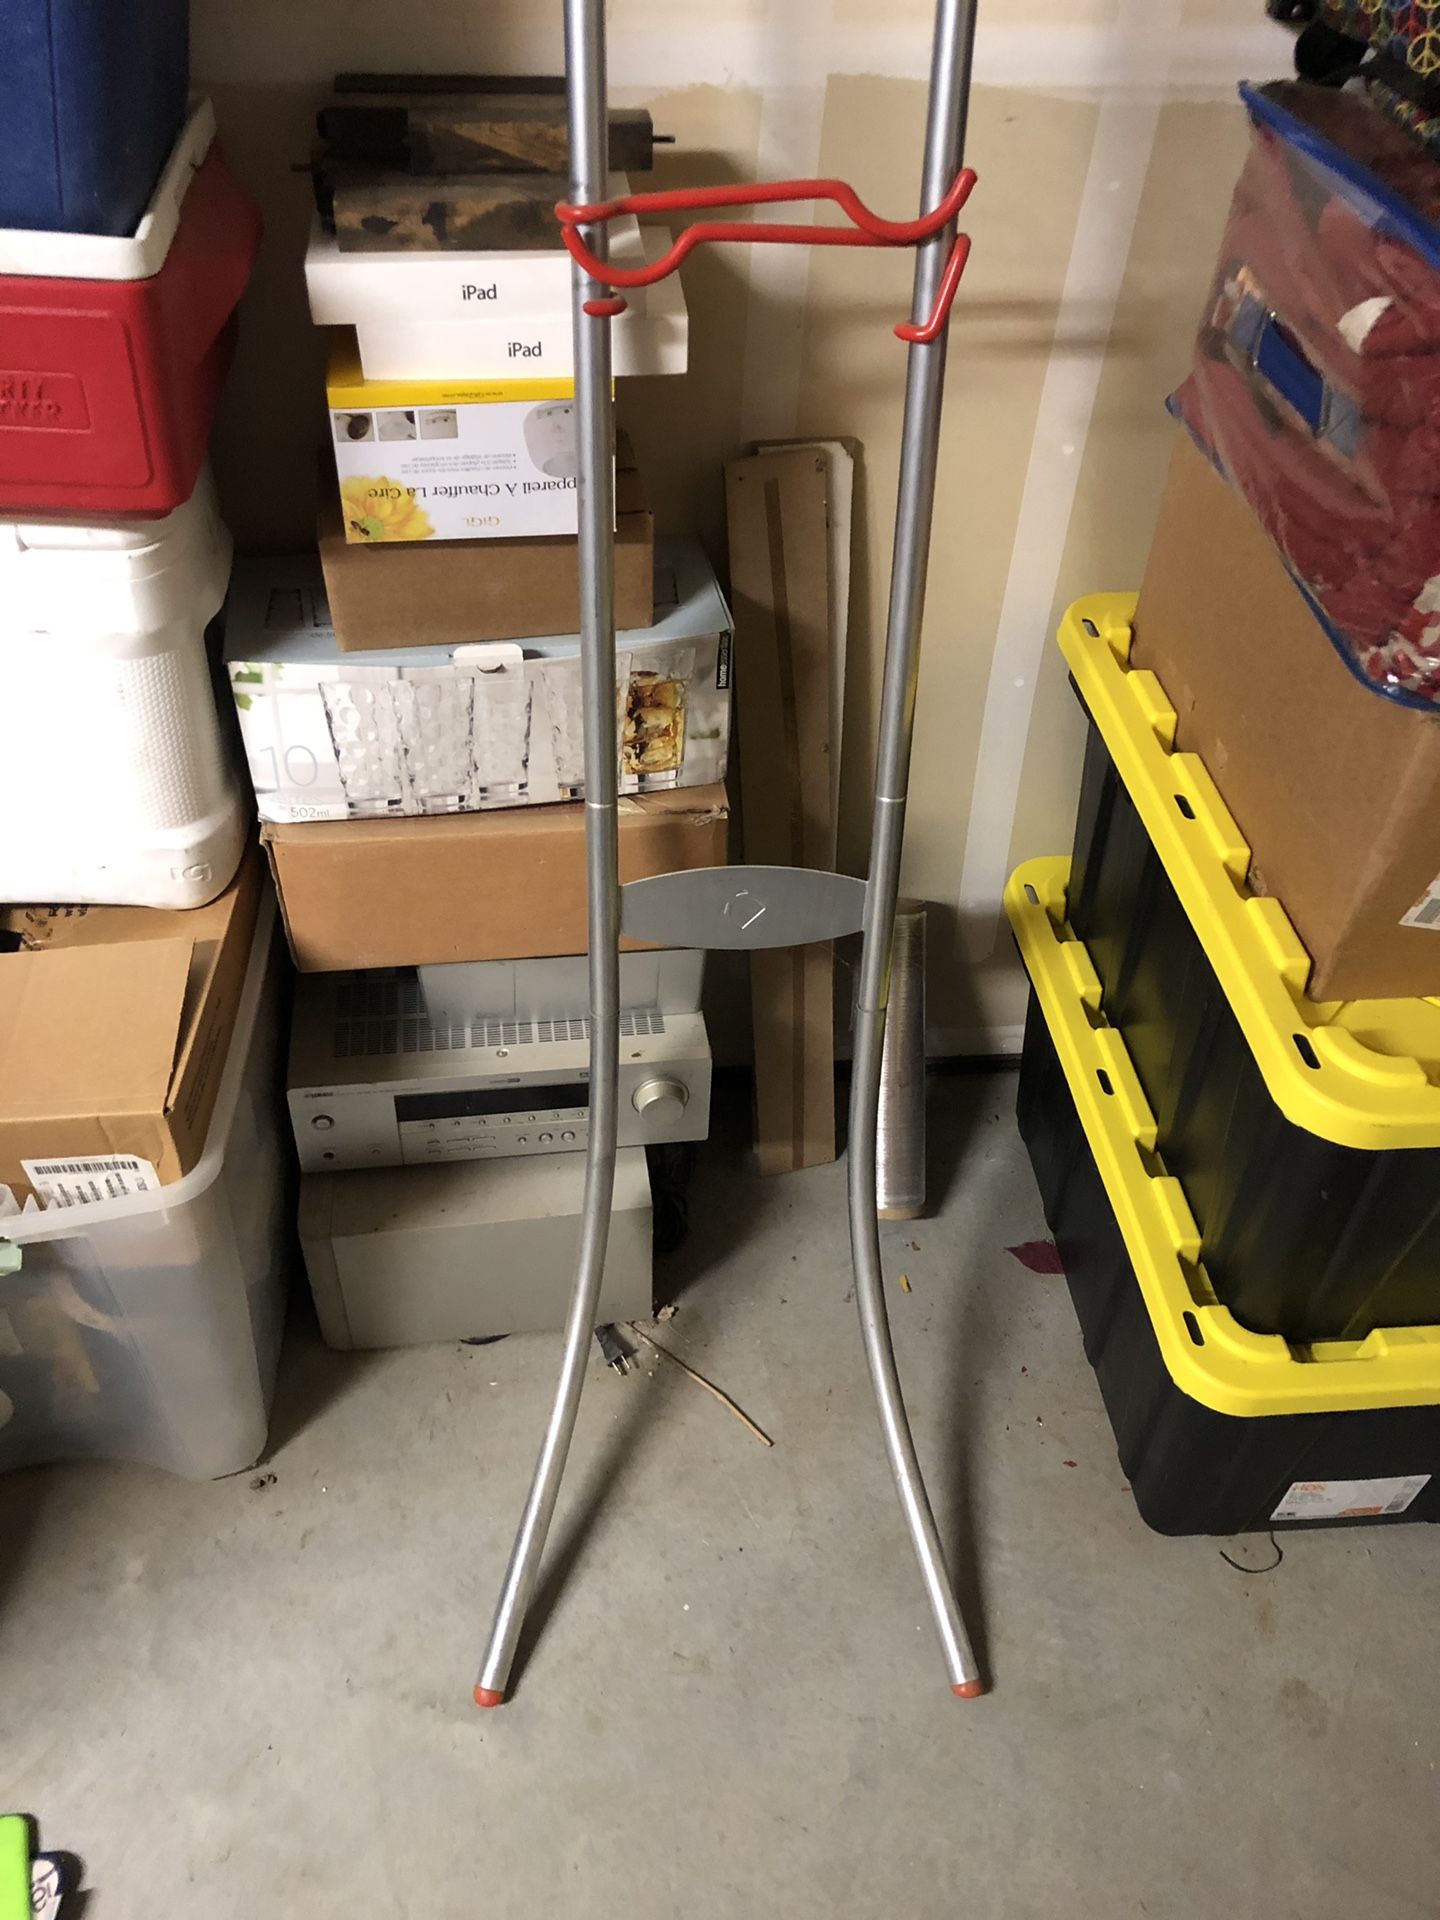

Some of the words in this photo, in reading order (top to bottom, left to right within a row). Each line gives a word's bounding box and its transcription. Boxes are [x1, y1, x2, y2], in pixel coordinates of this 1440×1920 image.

[462, 284, 497, 300] iPad
[508, 341, 542, 358] iPad
[368, 487, 401, 499] Cire
[406, 486, 427, 498] La
[432, 484, 500, 497] Chauffer
[522, 477, 577, 495] ppareil
[260, 745, 318, 789] 10
[290, 807, 330, 818] 502ml
